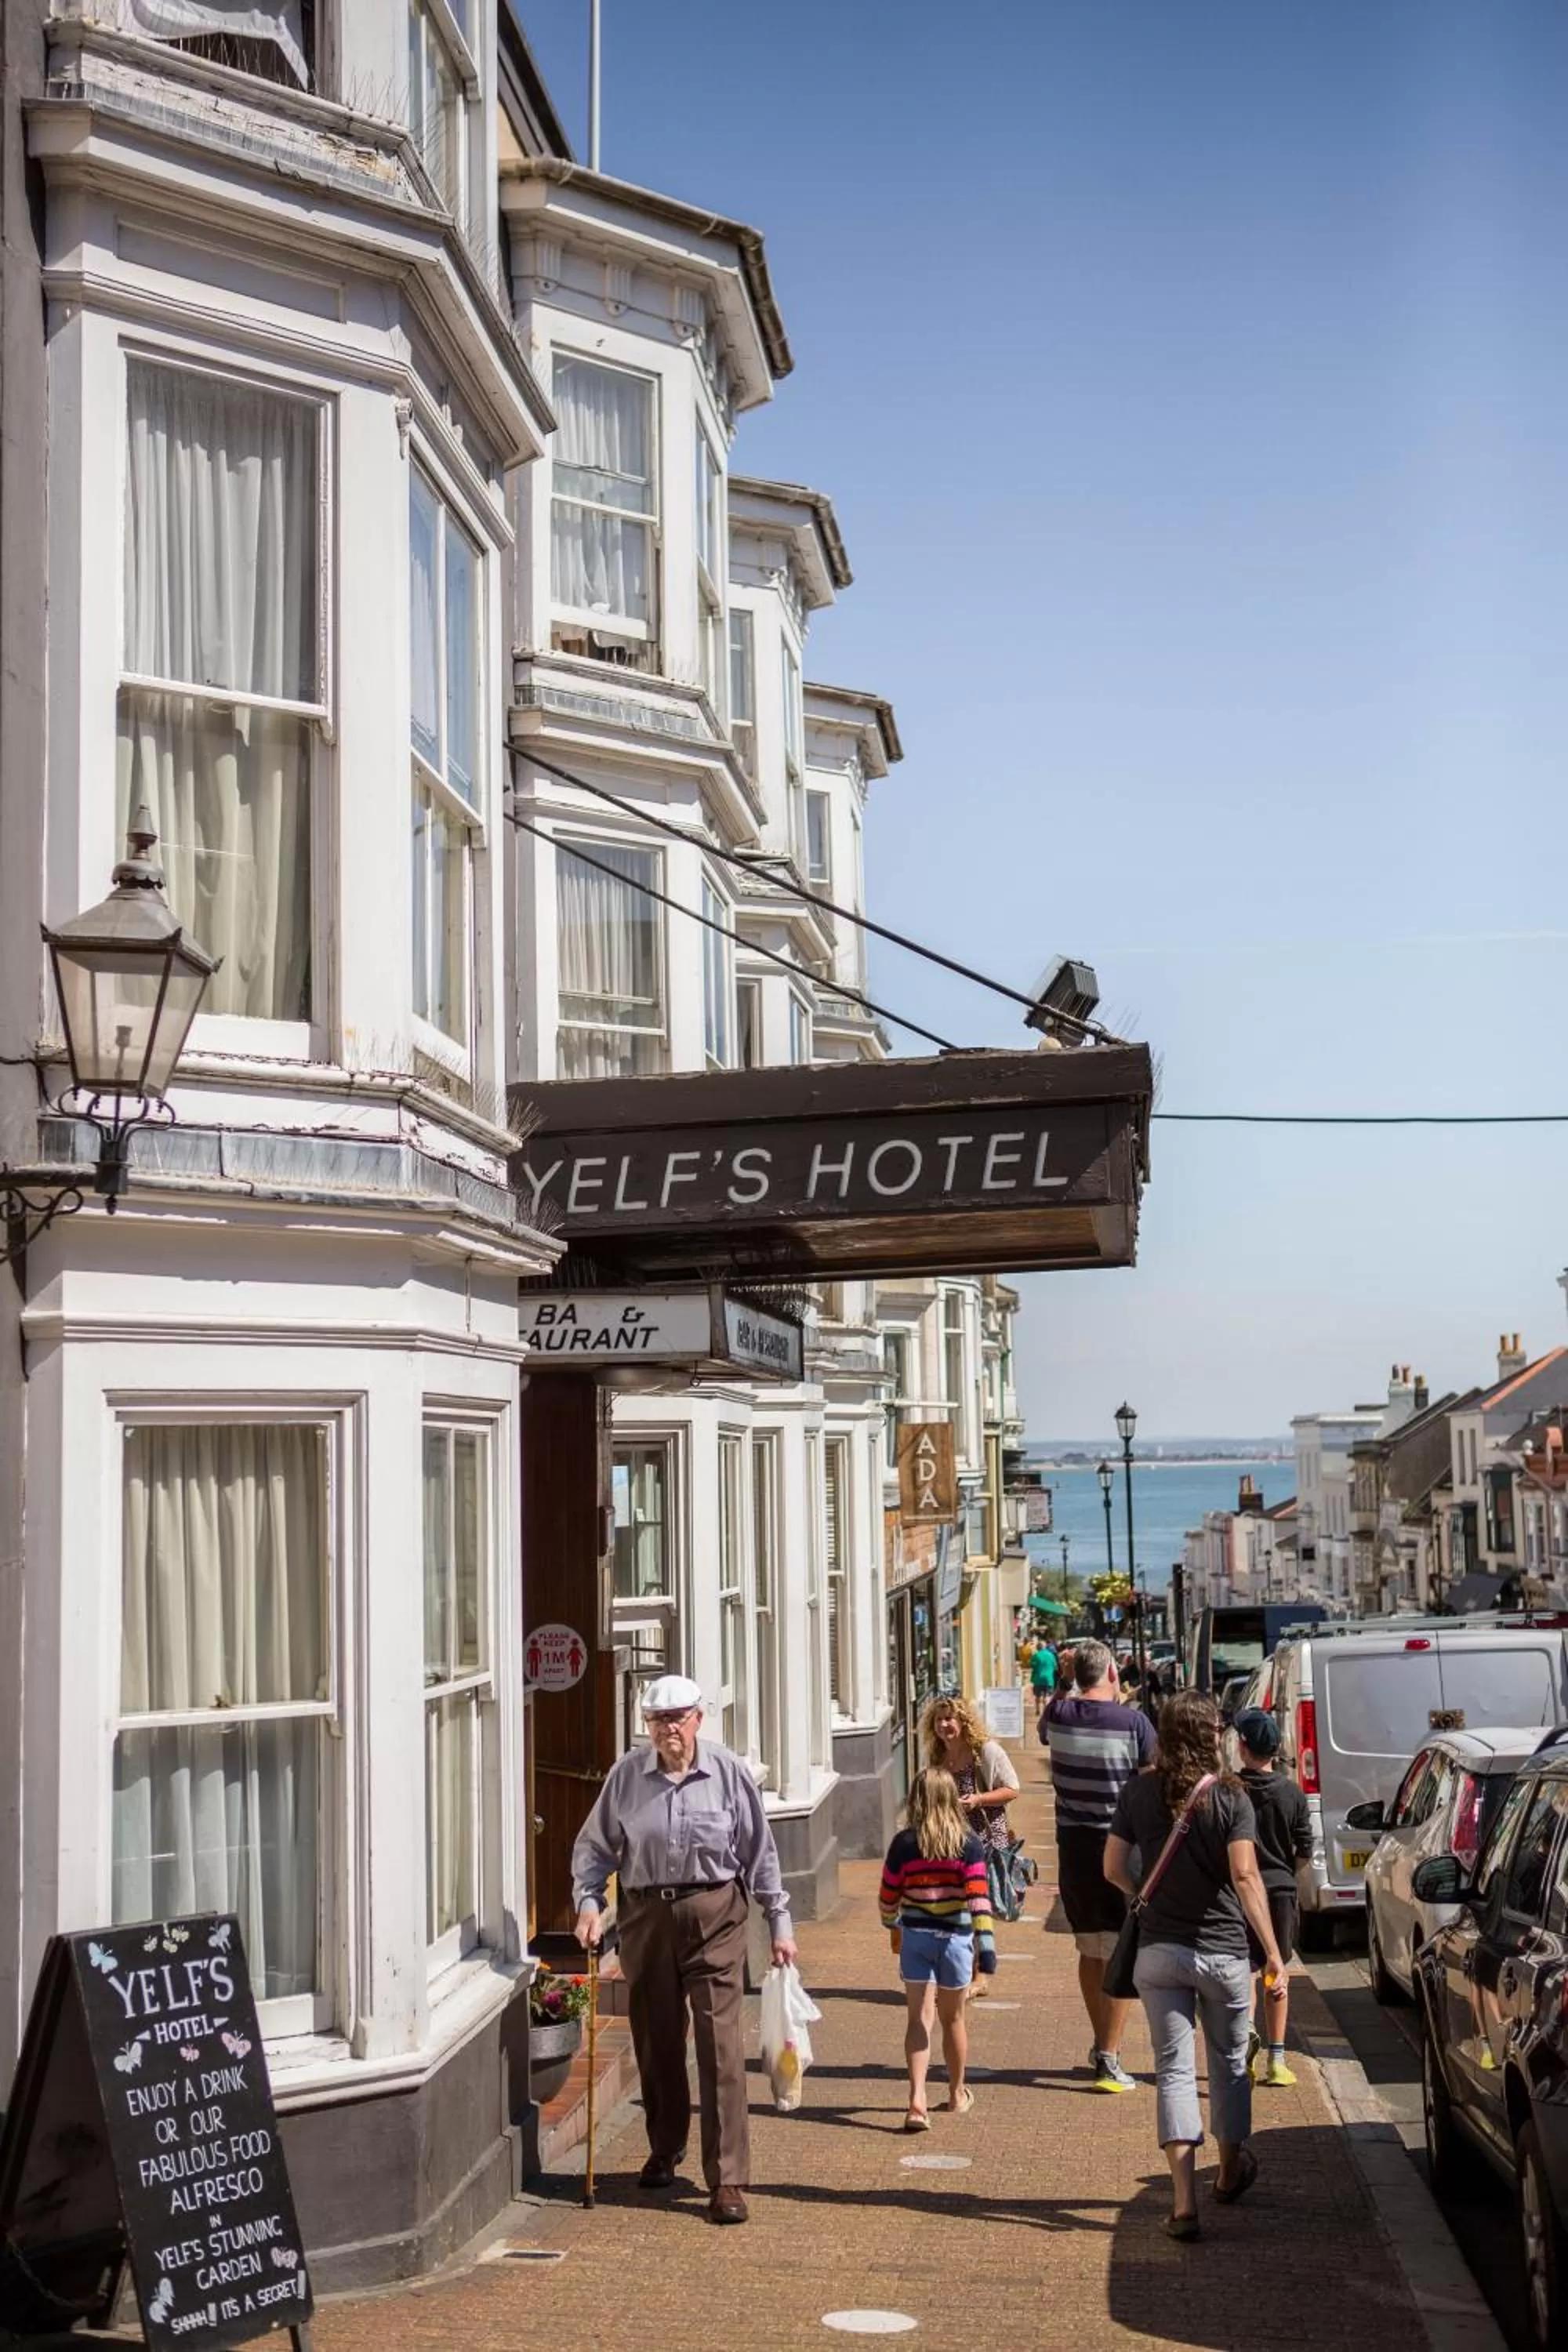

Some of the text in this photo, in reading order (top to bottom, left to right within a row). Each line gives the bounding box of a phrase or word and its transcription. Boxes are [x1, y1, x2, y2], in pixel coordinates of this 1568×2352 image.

[522, 1131, 1069, 1215] YELF'S HOTEL
[535, 1303, 644, 1325] BA &
[916, 1432, 940, 1508] ADA
[544, 1651, 565, 1664] 1M
[107, 1956, 234, 2018] YELF'S
[154, 2013, 214, 2044] HOTEL
[125, 2064, 249, 2116] ENJOY A DRINK
[155, 2105, 226, 2143] OR OUR
[138, 2129, 270, 2188] FABULOUS FOOD
[170, 2167, 263, 2215] ALFRESCO
[209, 2213, 222, 2228] IN
[209, 2215, 283, 2256] STUNNING
[197, 2252, 263, 2290] GARDEN
[245, 2294, 256, 2312] A
